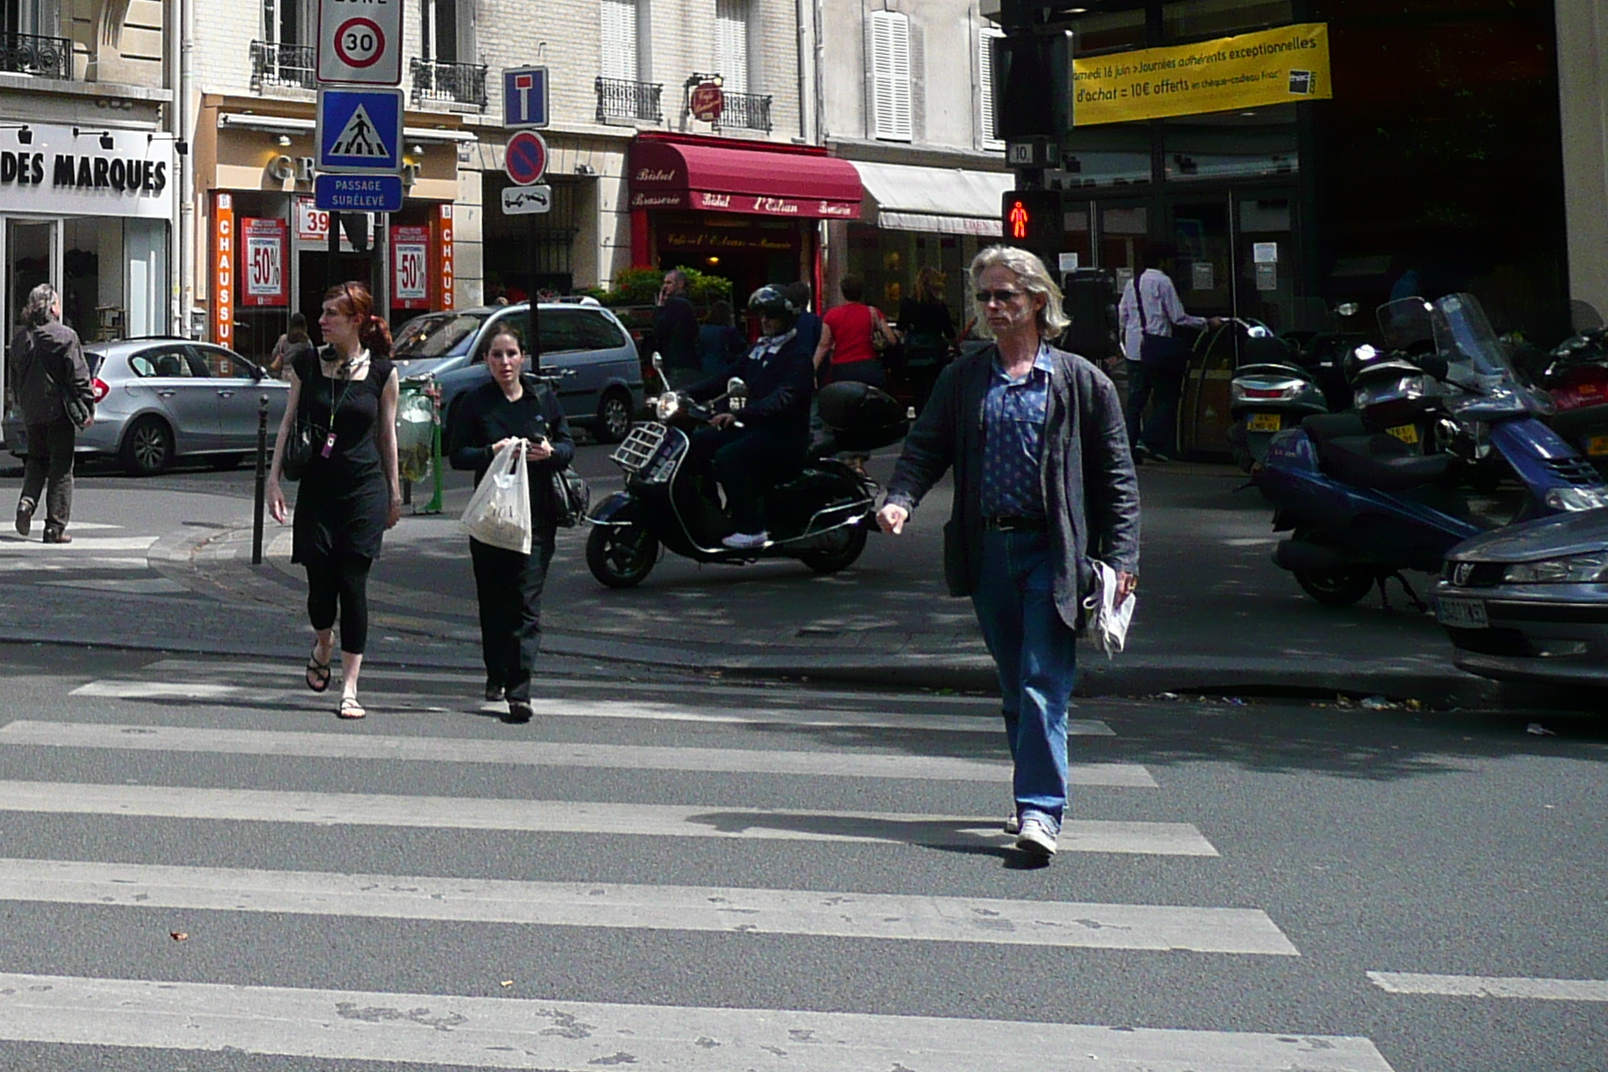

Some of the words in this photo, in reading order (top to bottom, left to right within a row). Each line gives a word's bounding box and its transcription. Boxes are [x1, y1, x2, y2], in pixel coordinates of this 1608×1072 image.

[346, 33, 373, 52] 30
[1073, 67, 1102, 81] amedi
[1229, 37, 1317, 60] exceptionnelles
[1077, 88, 1117, 103] d'achat
[1131, 83, 1150, 98] 10€
[1153, 78, 1189, 95] offerts
[0, 151, 44, 184] DES
[53, 154, 167, 194] MARQUES
[335, 180, 382, 192] PASSAGE
[331, 193, 385, 207] SURÉLEVÉ
[249, 247, 280, 286] -50%
[397, 253, 425, 290] -50%
